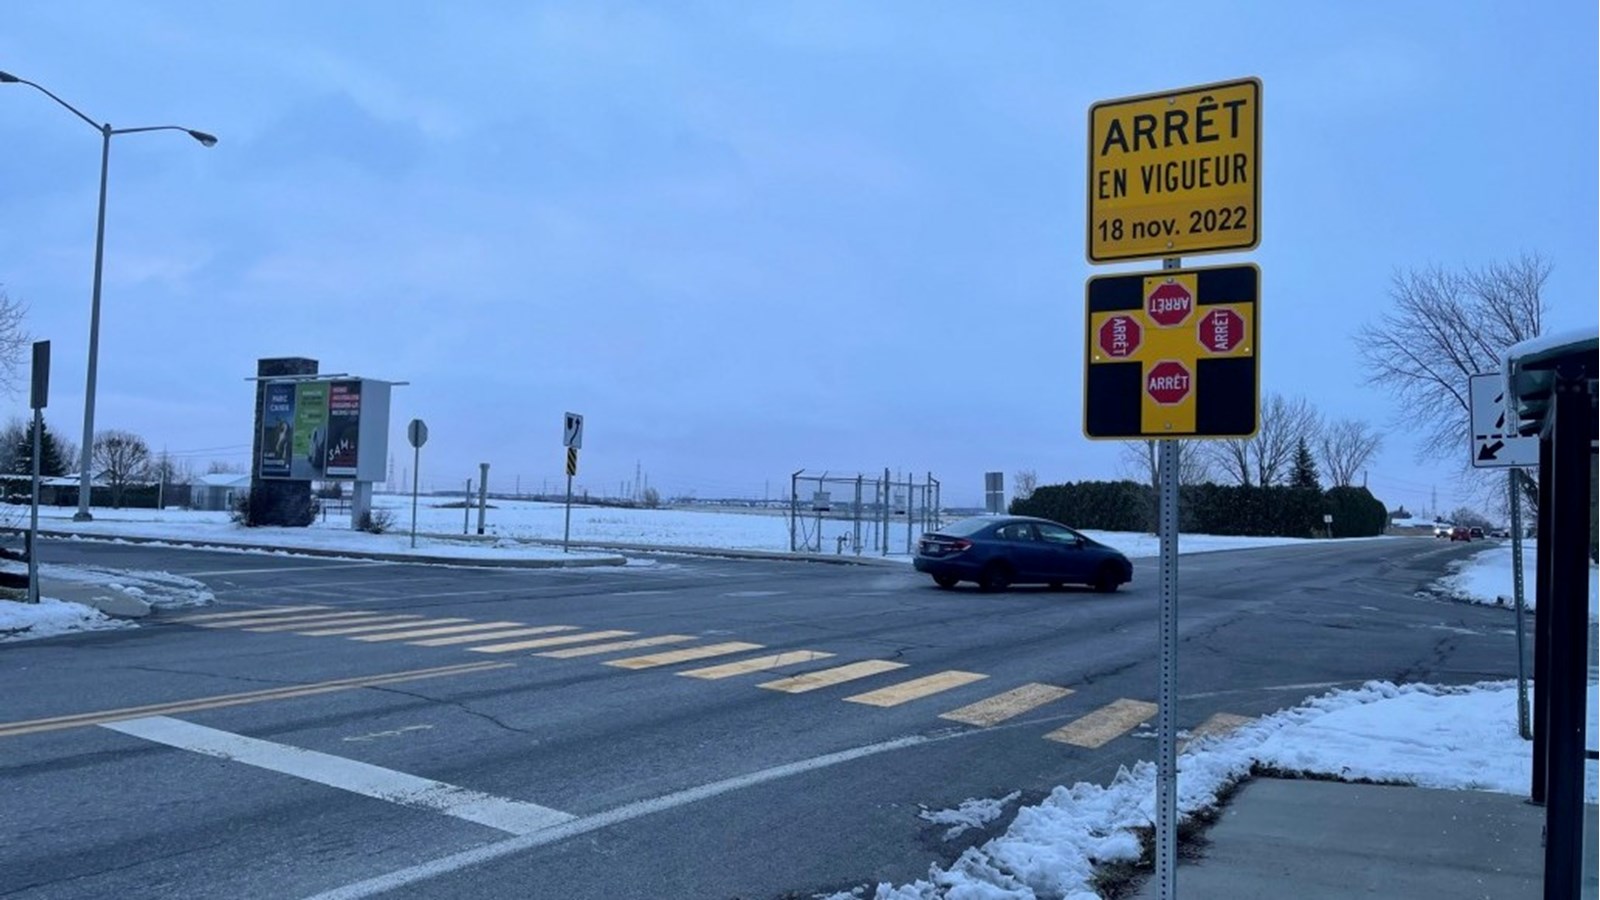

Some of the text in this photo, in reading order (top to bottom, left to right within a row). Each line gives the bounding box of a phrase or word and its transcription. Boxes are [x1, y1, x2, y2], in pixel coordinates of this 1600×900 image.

[1101, 96, 1247, 157] ARRÊT
[1099, 153, 1247, 200] EN VIGUEUR
[1098, 206, 1247, 242] 18 nov. 2022
[1150, 296, 1190, 314] ARRÊT
[1112, 318, 1130, 356] ARRÊT
[1212, 311, 1229, 350] ARRÊT
[1149, 373, 1188, 390] ARRÊT
